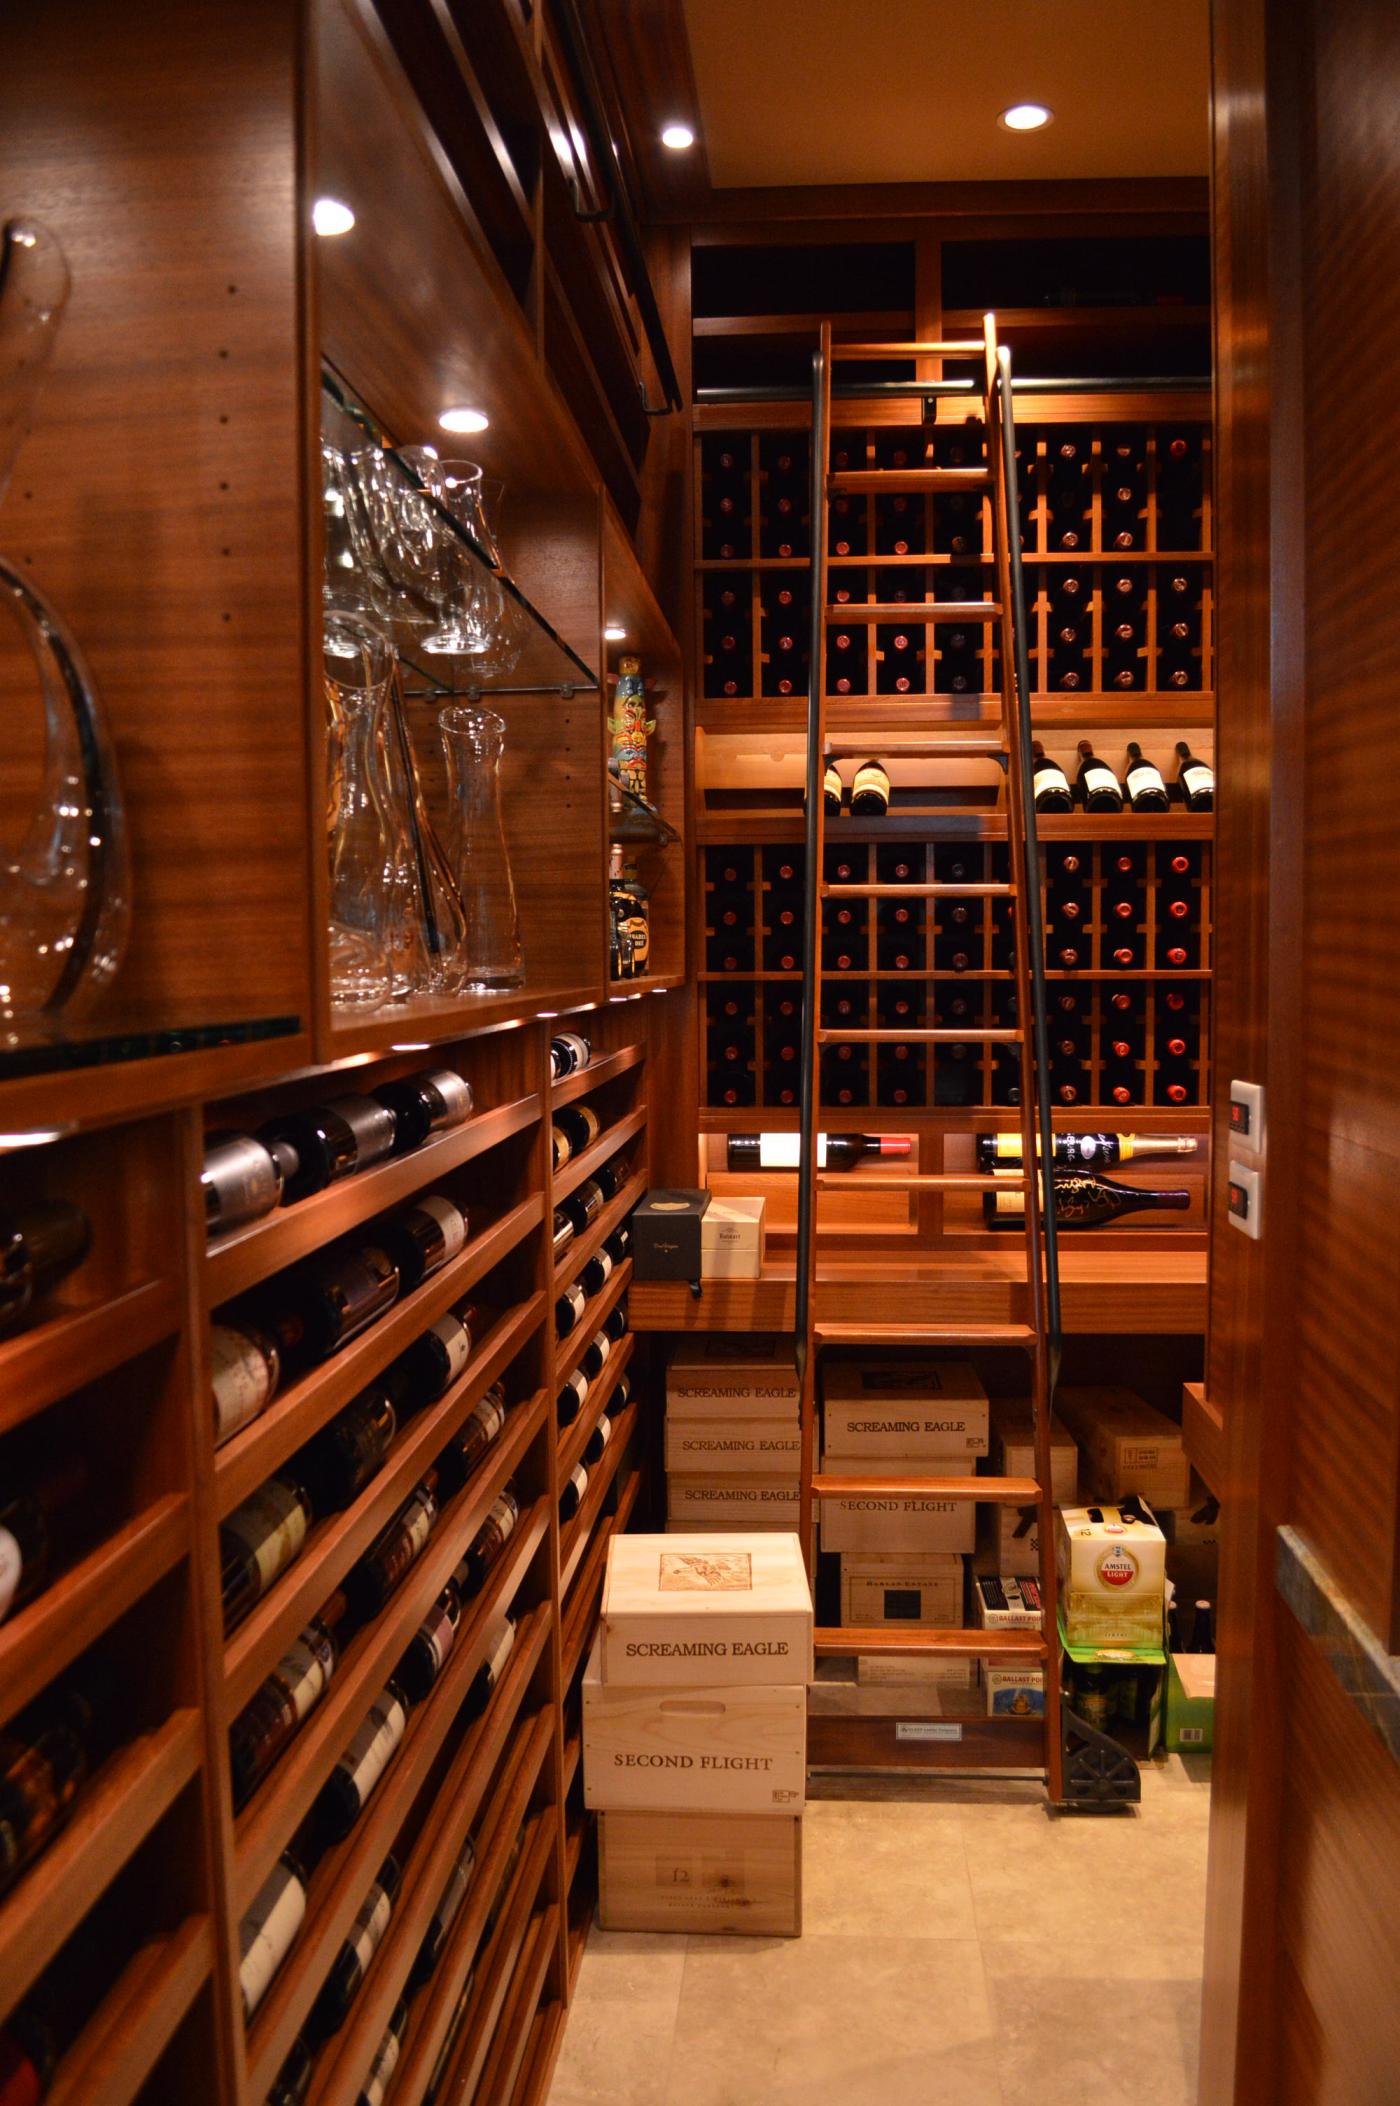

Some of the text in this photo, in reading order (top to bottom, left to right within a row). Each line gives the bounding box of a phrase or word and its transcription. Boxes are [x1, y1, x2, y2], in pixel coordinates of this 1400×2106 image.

[677, 1387, 797, 1399] SCREAMING EAGLE
[847, 1421, 966, 1433] SCREAMING EAGLE
[682, 1440, 800, 1452] SCREAMING EAGLE
[684, 1489, 800, 1501] SCREAMING EAGLE
[839, 1500, 958, 1512] SECOND FLIGHT
[625, 1642, 790, 1657] SCREAMING EAGLE
[1002, 1675, 1030, 1683] BALLAST
[613, 1754, 774, 1771] SECOND FLIGHT
